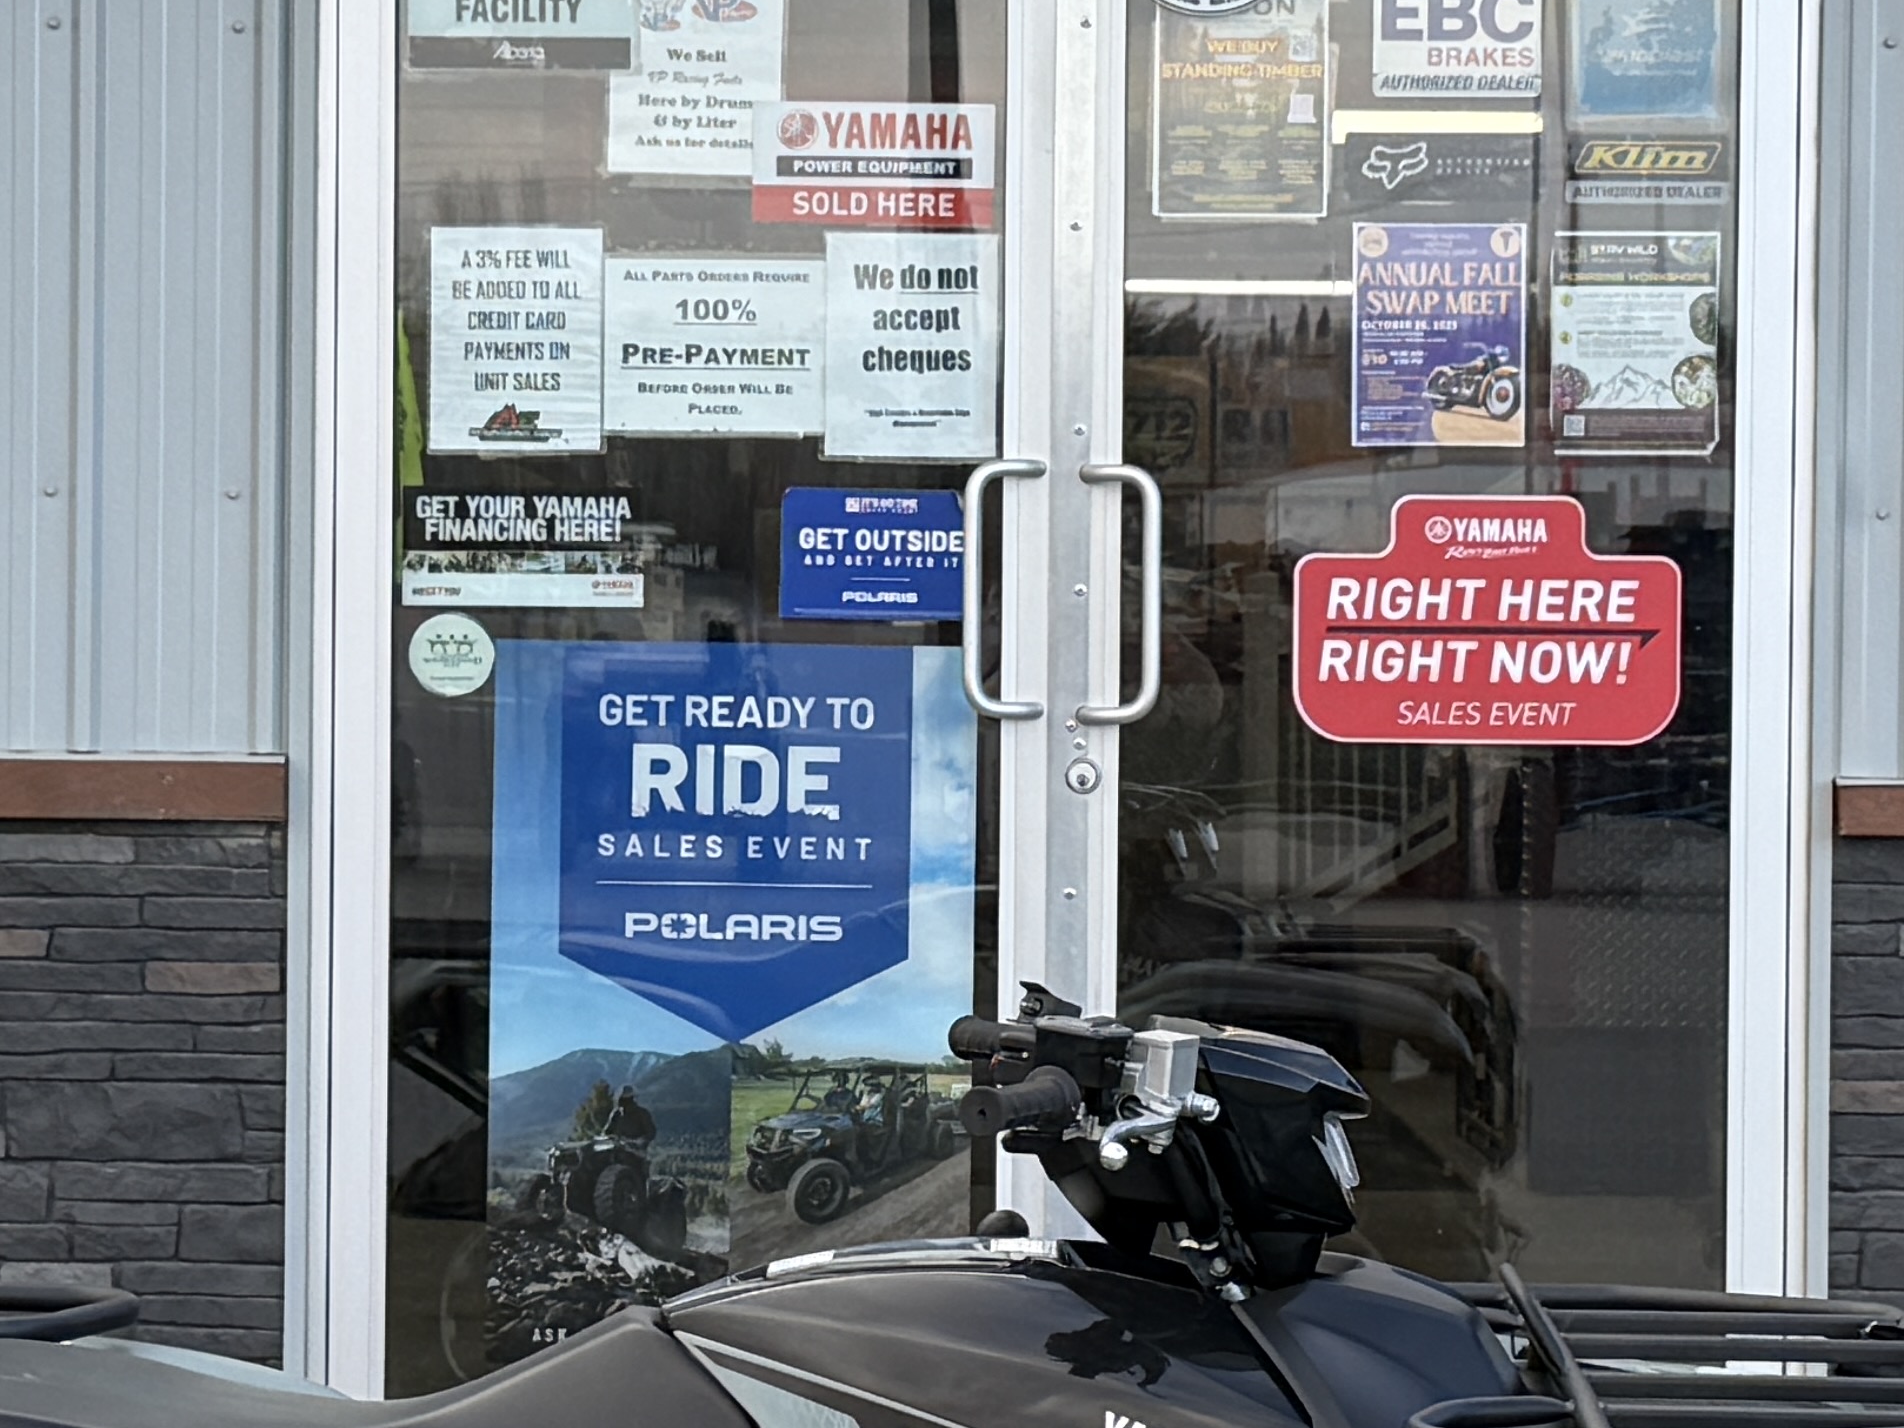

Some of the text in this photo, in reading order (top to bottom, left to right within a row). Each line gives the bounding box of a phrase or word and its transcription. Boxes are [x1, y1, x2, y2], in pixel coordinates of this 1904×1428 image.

[667, 48, 727, 62] We Sell
[1205, 39, 1280, 54] WE BUY
[1427, 47, 1535, 68] BRAKES
[1161, 62, 1324, 80] STANDING TIMBER
[1379, 75, 1535, 92] AUTHORIZED DEALER
[638, 94, 677, 107] Here
[681, 94, 702, 110] by
[672, 114, 693, 130] by
[697, 115, 737, 129] Liter
[822, 111, 973, 151] YAMAHA
[635, 135, 662, 147] Ask
[684, 136, 706, 148] for
[793, 160, 957, 175] POWER EQUIPMENT
[1583, 146, 1709, 169] Klim
[1666, 185, 1723, 199] DEALER
[793, 191, 956, 218] SOLD HERE
[461, 250, 571, 269] A 3% FEE WILL
[853, 264, 980, 290] We do not
[1358, 261, 1522, 287] ANNUAL FALL
[452, 280, 581, 300] BE ADDED TO ALL
[675, 298, 757, 322] 100%
[1366, 289, 1514, 316] SWAP MEET
[467, 311, 566, 331] CREDIT CARD
[872, 306, 961, 333] accept
[464, 341, 571, 361] PAYMENTS ON
[621, 343, 811, 366] PRE-PAYMENT
[862, 345, 972, 374] cheques
[474, 372, 562, 391] UNIT SALES
[416, 495, 633, 519] GET YOUR YAMAHA
[424, 518, 622, 542] FINANCING HERE!
[798, 527, 964, 553] GET OUTSIDE
[1454, 518, 1548, 543] YAMAHA
[804, 554, 960, 568] AND GET AFTER IT
[841, 591, 919, 603] POLARIS
[1325, 577, 1641, 623] RIGHT HERE
[1318, 639, 1633, 684] RIGHT NOW!
[598, 693, 875, 730] GET READY TO
[1397, 700, 1577, 727] SALES EVENT
[631, 743, 841, 820] RIDE
[597, 833, 873, 861] SALES EVENT
[624, 912, 844, 942] POLARIS
